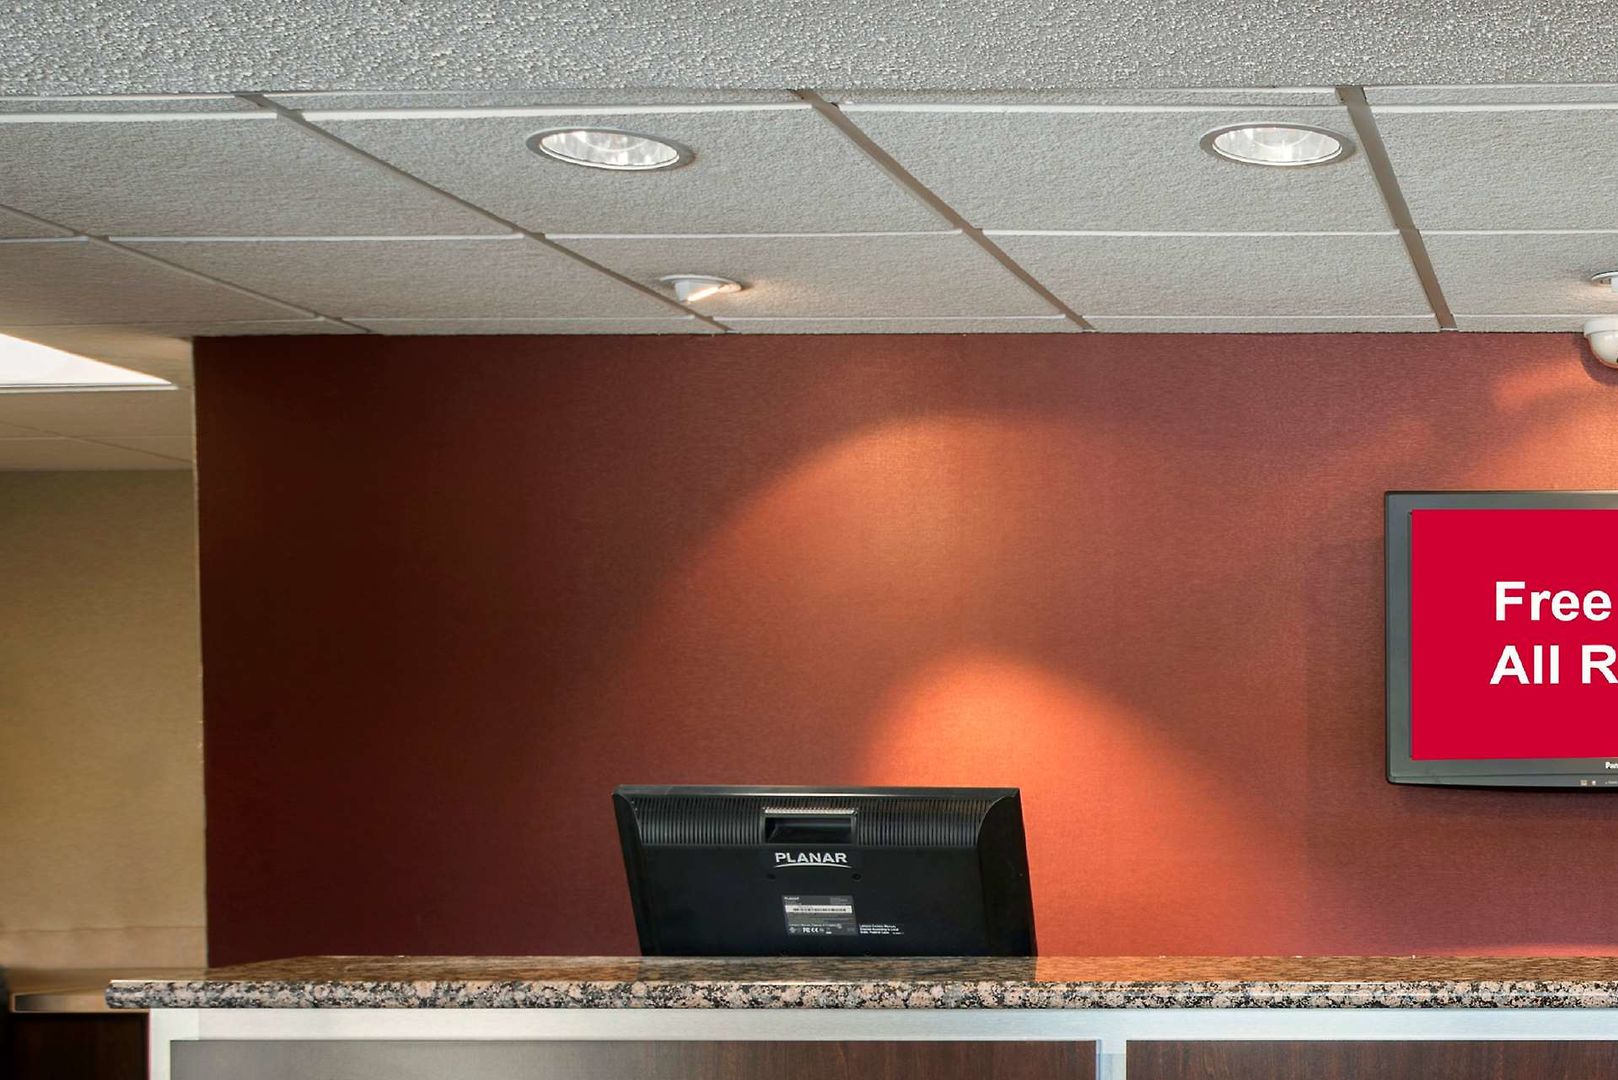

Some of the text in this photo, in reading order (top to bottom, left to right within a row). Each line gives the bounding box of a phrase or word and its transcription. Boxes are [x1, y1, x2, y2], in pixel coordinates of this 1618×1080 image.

[1495, 581, 1612, 622] Free
[1489, 644, 1560, 685] All
[774, 852, 848, 863] PLANAR
